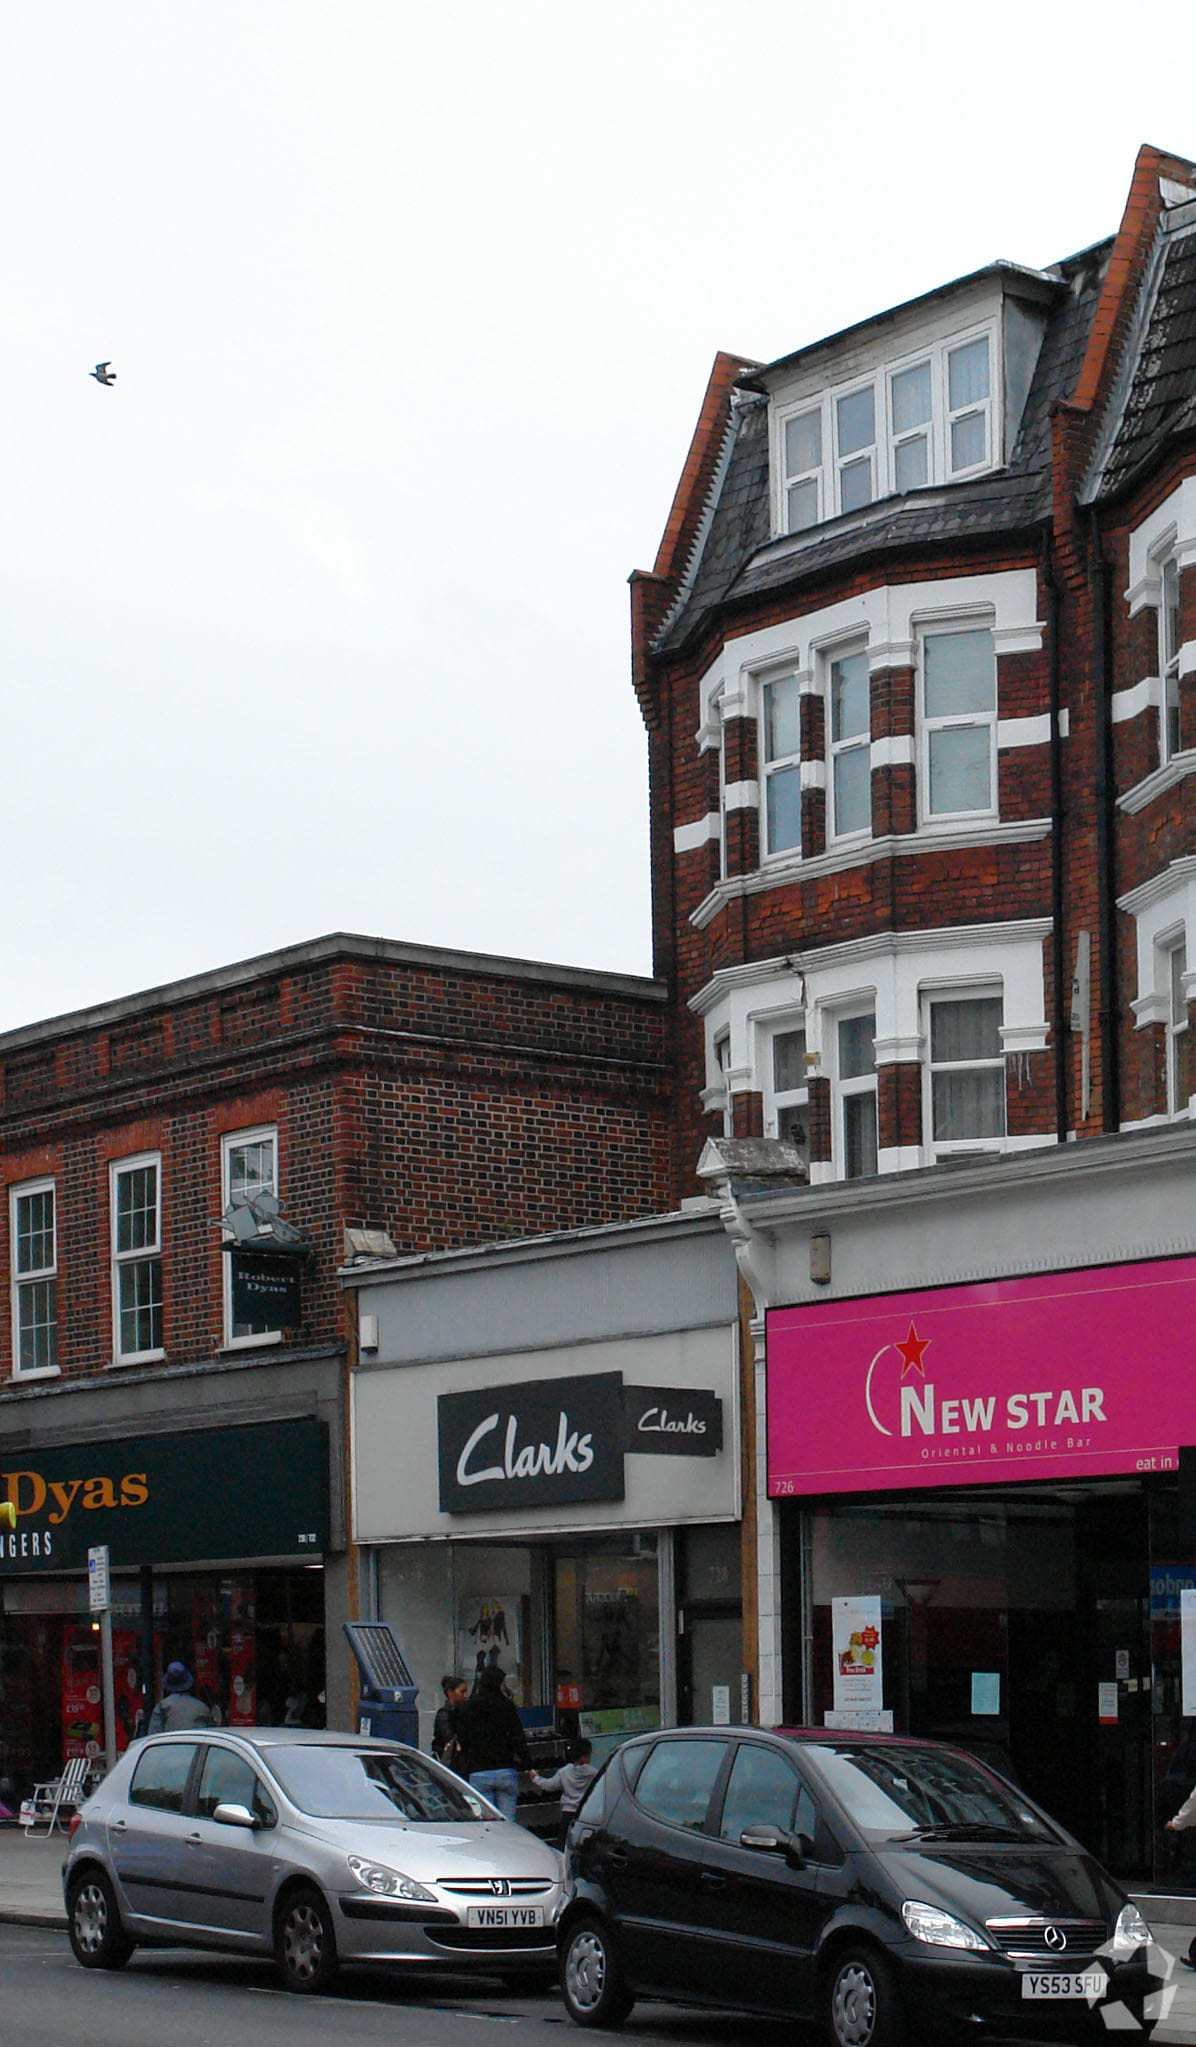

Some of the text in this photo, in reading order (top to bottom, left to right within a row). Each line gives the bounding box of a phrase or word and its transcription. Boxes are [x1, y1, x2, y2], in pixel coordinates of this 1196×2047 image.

[237, 1271, 296, 1284] Robert
[246, 1282, 288, 1293] Dyas
[1006, 1387, 1108, 1430] STAR
[637, 1406, 708, 1435] Clarks
[456, 1410, 595, 1487] Clarks
[921, 1436, 1094, 1460] Oriental & Noodle Bar
[1136, 1455, 1172, 1470] eat in
[774, 1481, 795, 1495] 726
[0, 1471, 149, 1525] Dyas
[475, 1909, 538, 1924] VN51 YVB
[1030, 1976, 1102, 1995] YS53 SFU
